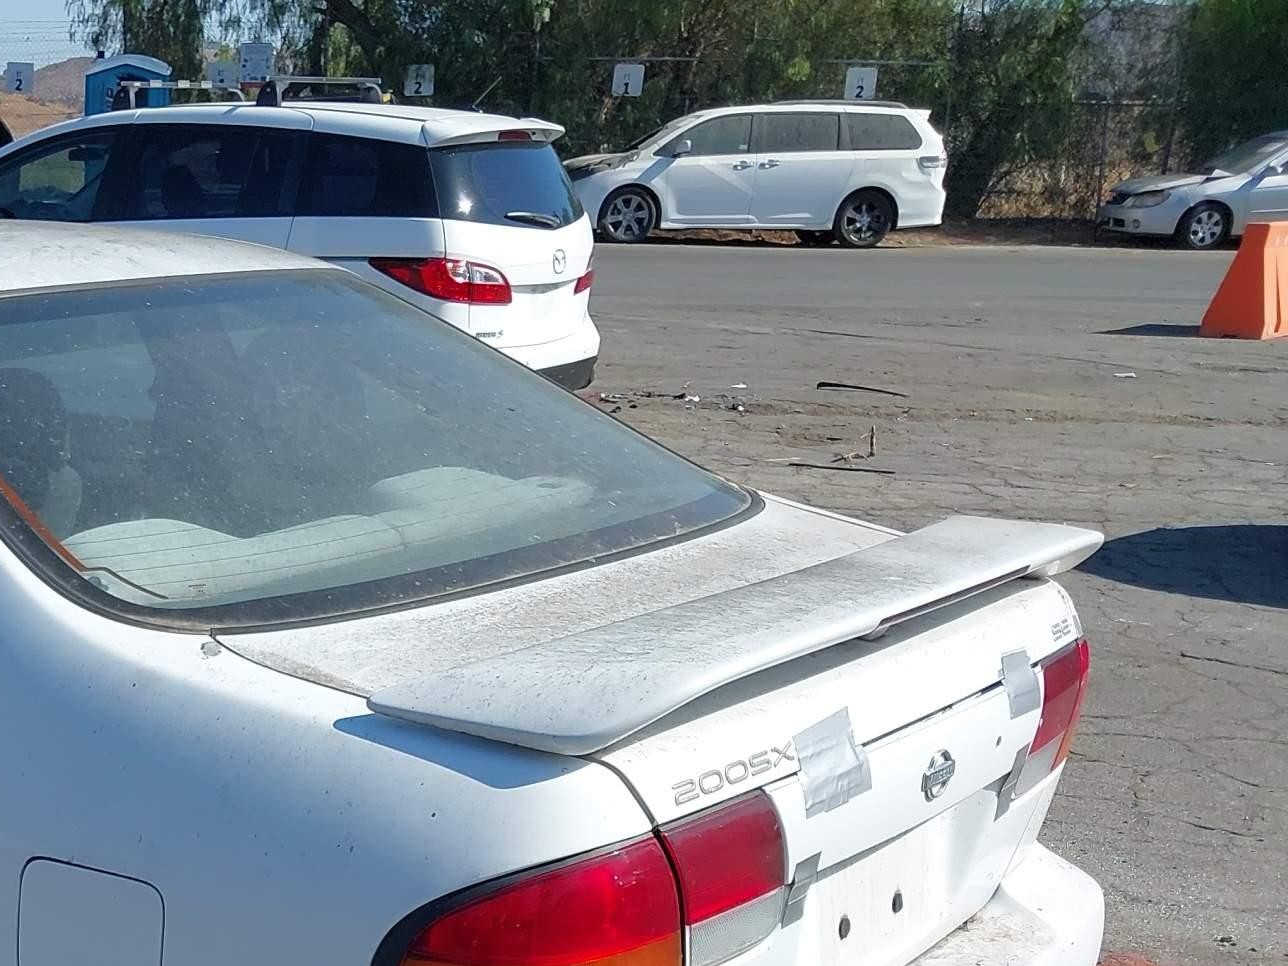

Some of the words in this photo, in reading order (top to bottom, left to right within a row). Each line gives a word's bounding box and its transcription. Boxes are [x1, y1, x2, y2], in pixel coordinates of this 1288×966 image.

[15, 78, 23, 91] 2
[414, 81, 423, 95] 2
[623, 82, 630, 95] 1
[855, 85, 864, 98] 2
[671, 740, 795, 807] 200SX
